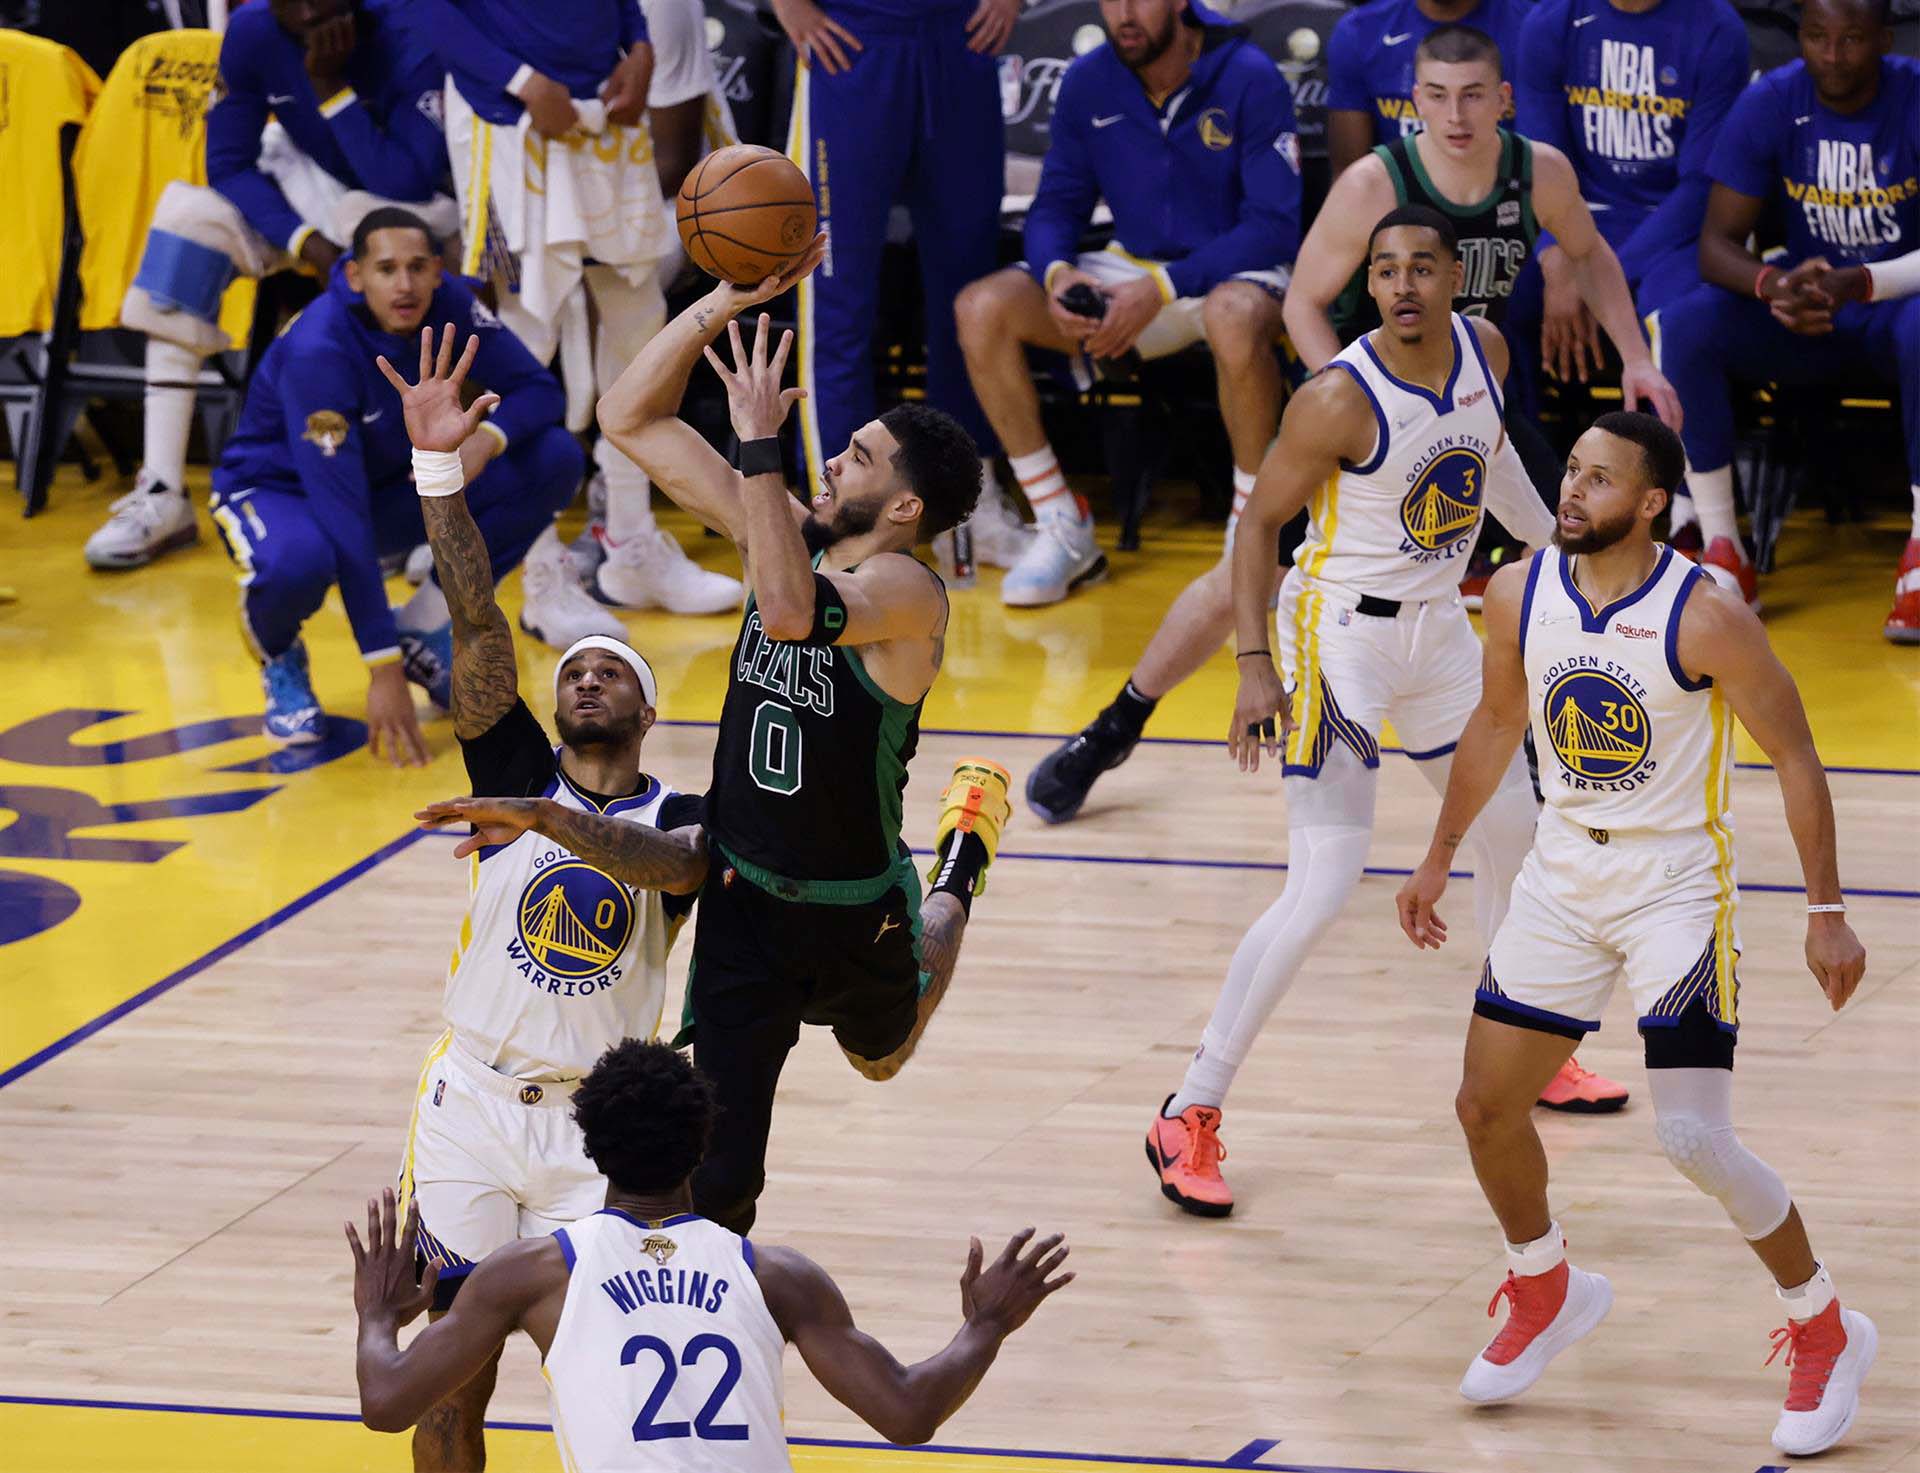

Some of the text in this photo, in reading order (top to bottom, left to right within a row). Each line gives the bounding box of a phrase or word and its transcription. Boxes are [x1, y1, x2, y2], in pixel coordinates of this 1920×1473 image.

[1601, 38, 1656, 100] NBA
[1564, 85, 1693, 119] WARRIOR
[1583, 104, 1675, 160] FINALS
[1818, 138, 1878, 193] NBA
[1783, 176, 1919, 209] WARRIORS
[1802, 200, 1902, 247] FINALS
[1457, 236, 1526, 298] TICS
[1406, 433, 1491, 483] GOLDEN STATE
[1462, 467, 1476, 498] 3
[1616, 623, 1658, 640] Rakuten
[1543, 655, 1648, 700] GOLDEN STATE
[1600, 701, 1639, 733] 30
[749, 700, 803, 796] 0
[1560, 758, 1658, 792] ARRIORS
[594, 898, 617, 930] 0
[506, 936, 623, 997] WARRIORS
[640, 1237, 678, 1254] Finals
[601, 1267, 729, 1315] WIGGINS
[620, 1332, 750, 1442] 22
